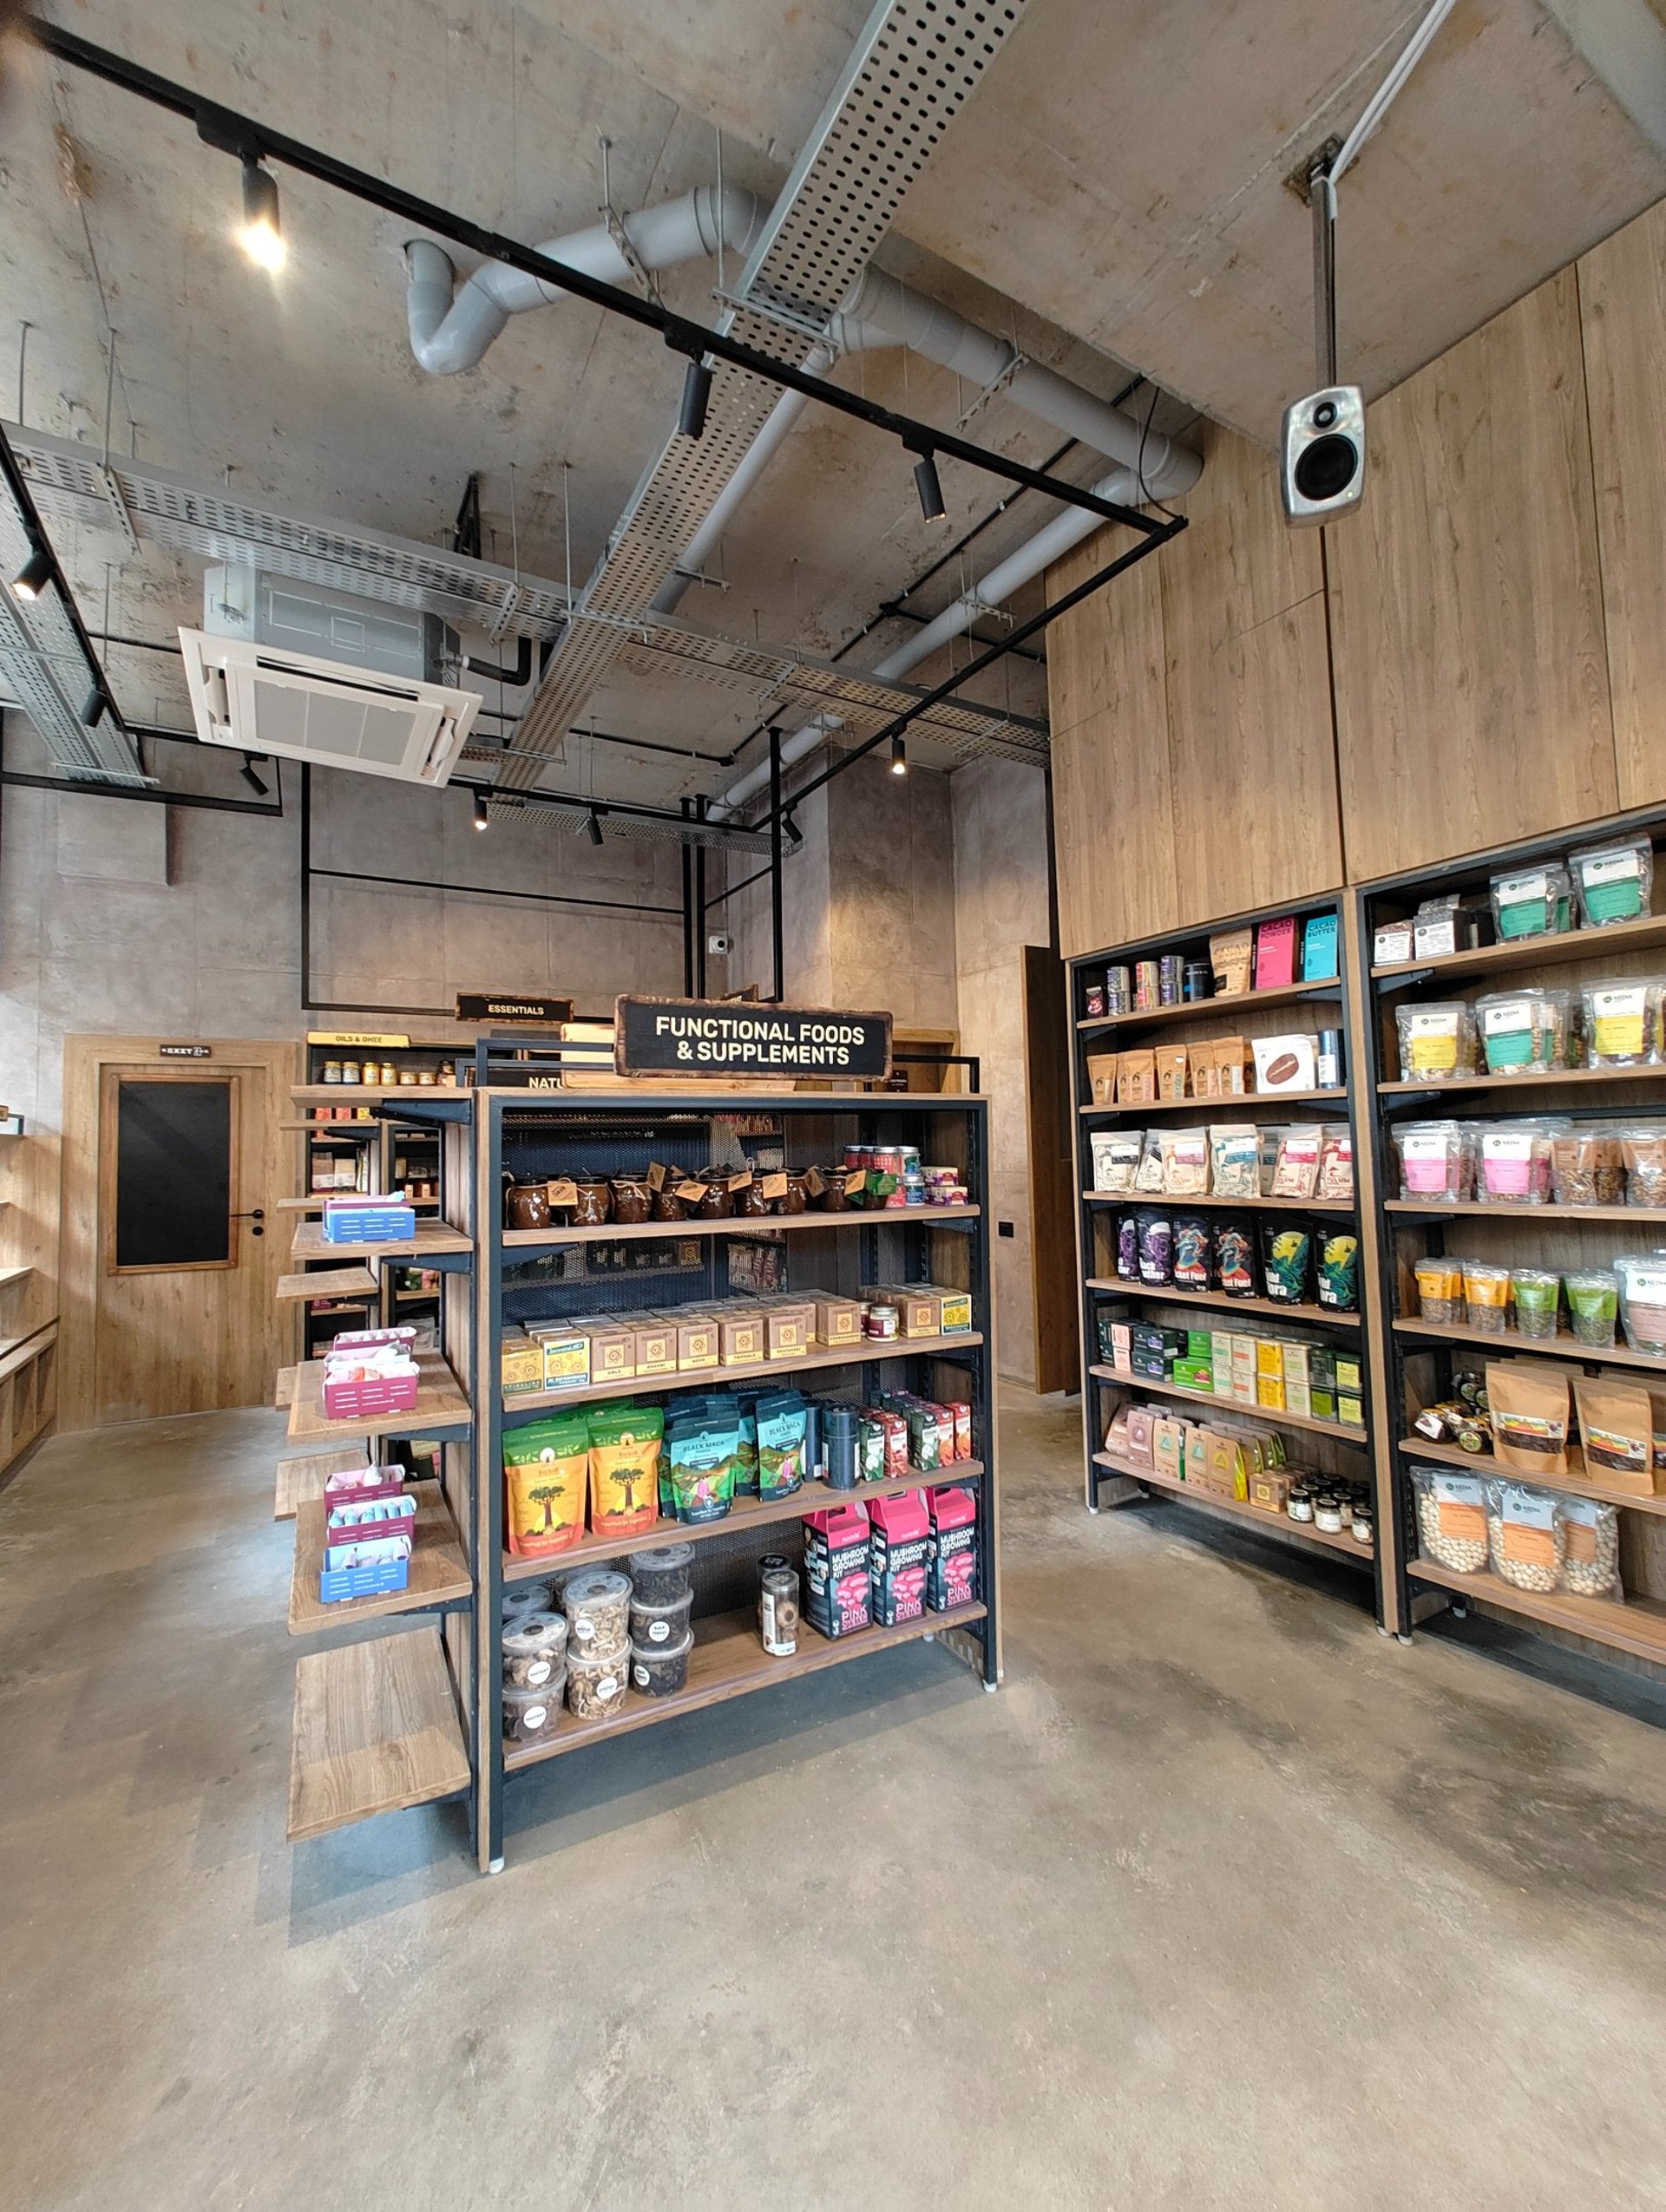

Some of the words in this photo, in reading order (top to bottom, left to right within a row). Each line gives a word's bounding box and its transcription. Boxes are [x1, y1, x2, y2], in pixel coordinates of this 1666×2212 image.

[1261, 919, 1292, 933] CACAO
[1307, 926, 1336, 938] BUTTER
[1308, 919, 1336, 931] CACAO
[1260, 928, 1291, 939] POWDER
[489, 1005, 544, 1015] ESSENTIALS
[656, 1016, 795, 1041] FUNCTIONAL
[799, 1024, 865, 1045] FOODS
[676, 1041, 693, 1060] &
[697, 1041, 849, 1065] SUPPLEMENTS
[1190, 1272, 1207, 1281] Fuel
[1234, 1278, 1251, 1287] Fuel
[770, 1425, 785, 1436] BLACK
[786, 1421, 800, 1430] MACA
[683, 1443, 704, 1452] BLACK
[941, 1527, 974, 1543] MUSHROOM
[890, 1542, 928, 1558] MUSHROOM
[941, 1537, 970, 1551] GROWING
[832, 1544, 869, 1564] MUSHROOM
[890, 1552, 922, 1565] GROWING
[832, 1556, 865, 1571] GROWING
[833, 1569, 843, 1579] KIT
[948, 1581, 971, 1597] PINK
[842, 1604, 867, 1620] PINK
[895, 1598, 922, 1613] PINK
